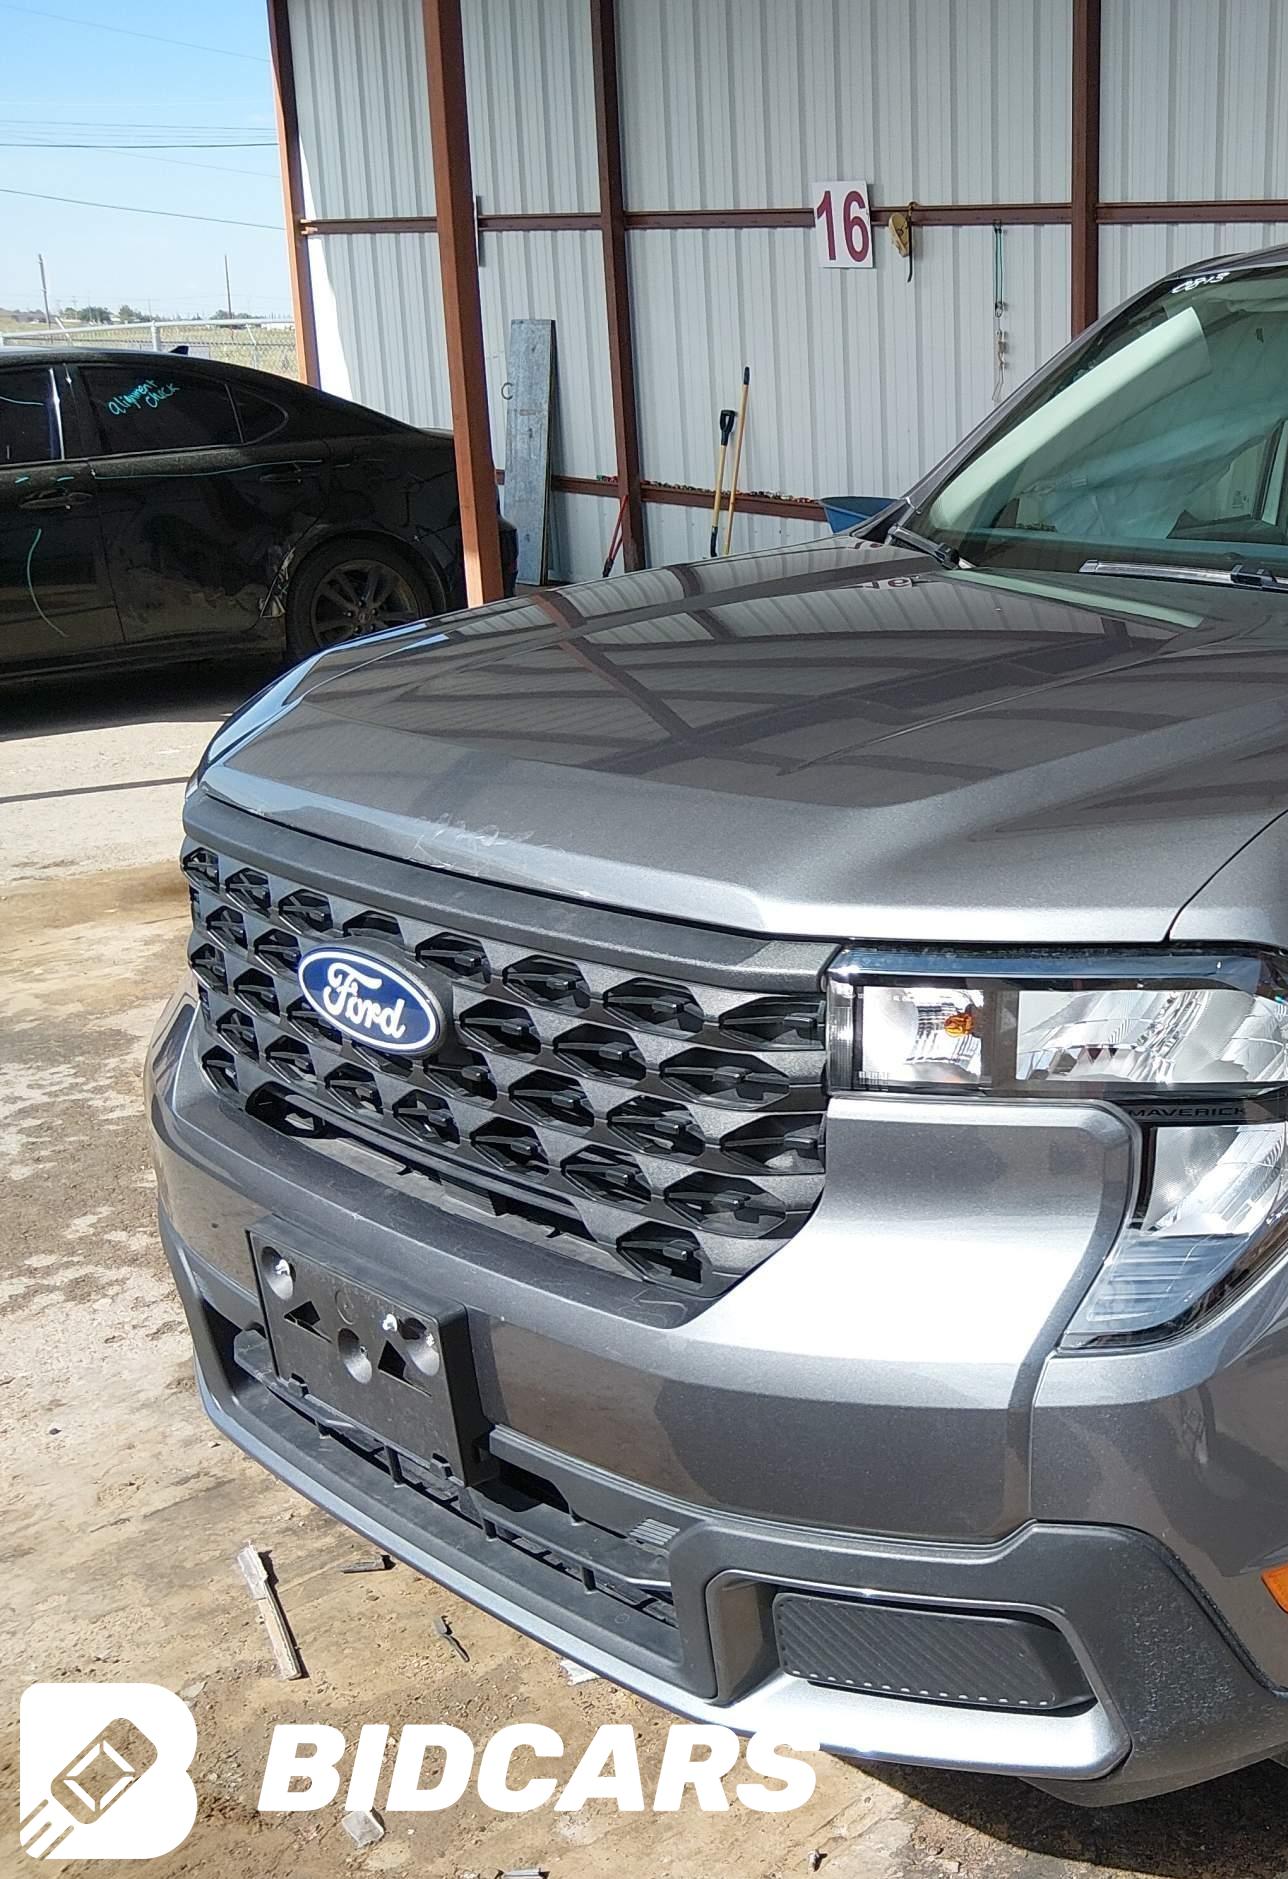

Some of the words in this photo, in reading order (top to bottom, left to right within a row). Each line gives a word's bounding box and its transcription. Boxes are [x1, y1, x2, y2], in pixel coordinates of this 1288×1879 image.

[816, 190, 870, 263] 16
[323, 962, 406, 1039] Ford
[1127, 1107, 1246, 1117] MAVERICK
